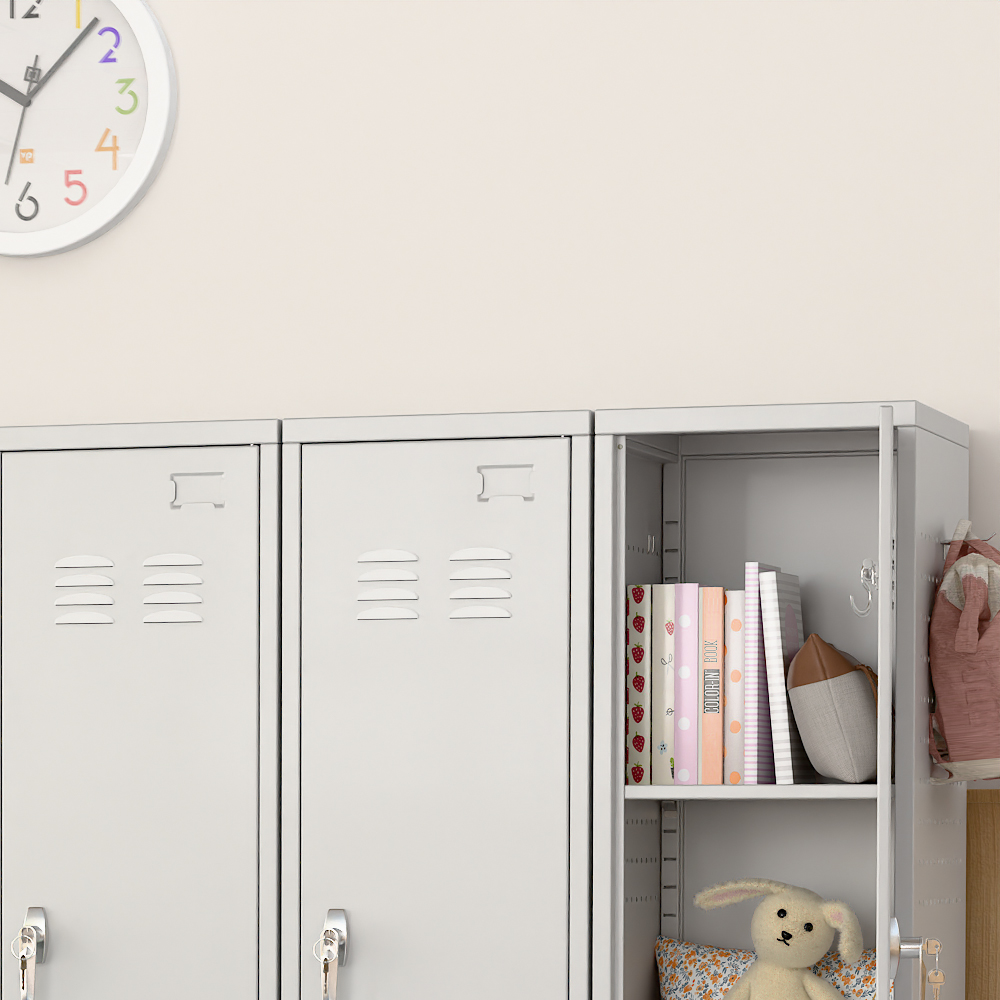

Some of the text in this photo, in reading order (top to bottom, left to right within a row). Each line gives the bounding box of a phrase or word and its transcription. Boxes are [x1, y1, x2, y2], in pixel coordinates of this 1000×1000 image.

[97, 26, 121, 64] 2
[114, 77, 139, 115] 3
[94, 128, 120, 170] 4
[15, 181, 39, 221] 6
[63, 169, 88, 206] 5
[704, 640, 717, 662] BOOK
